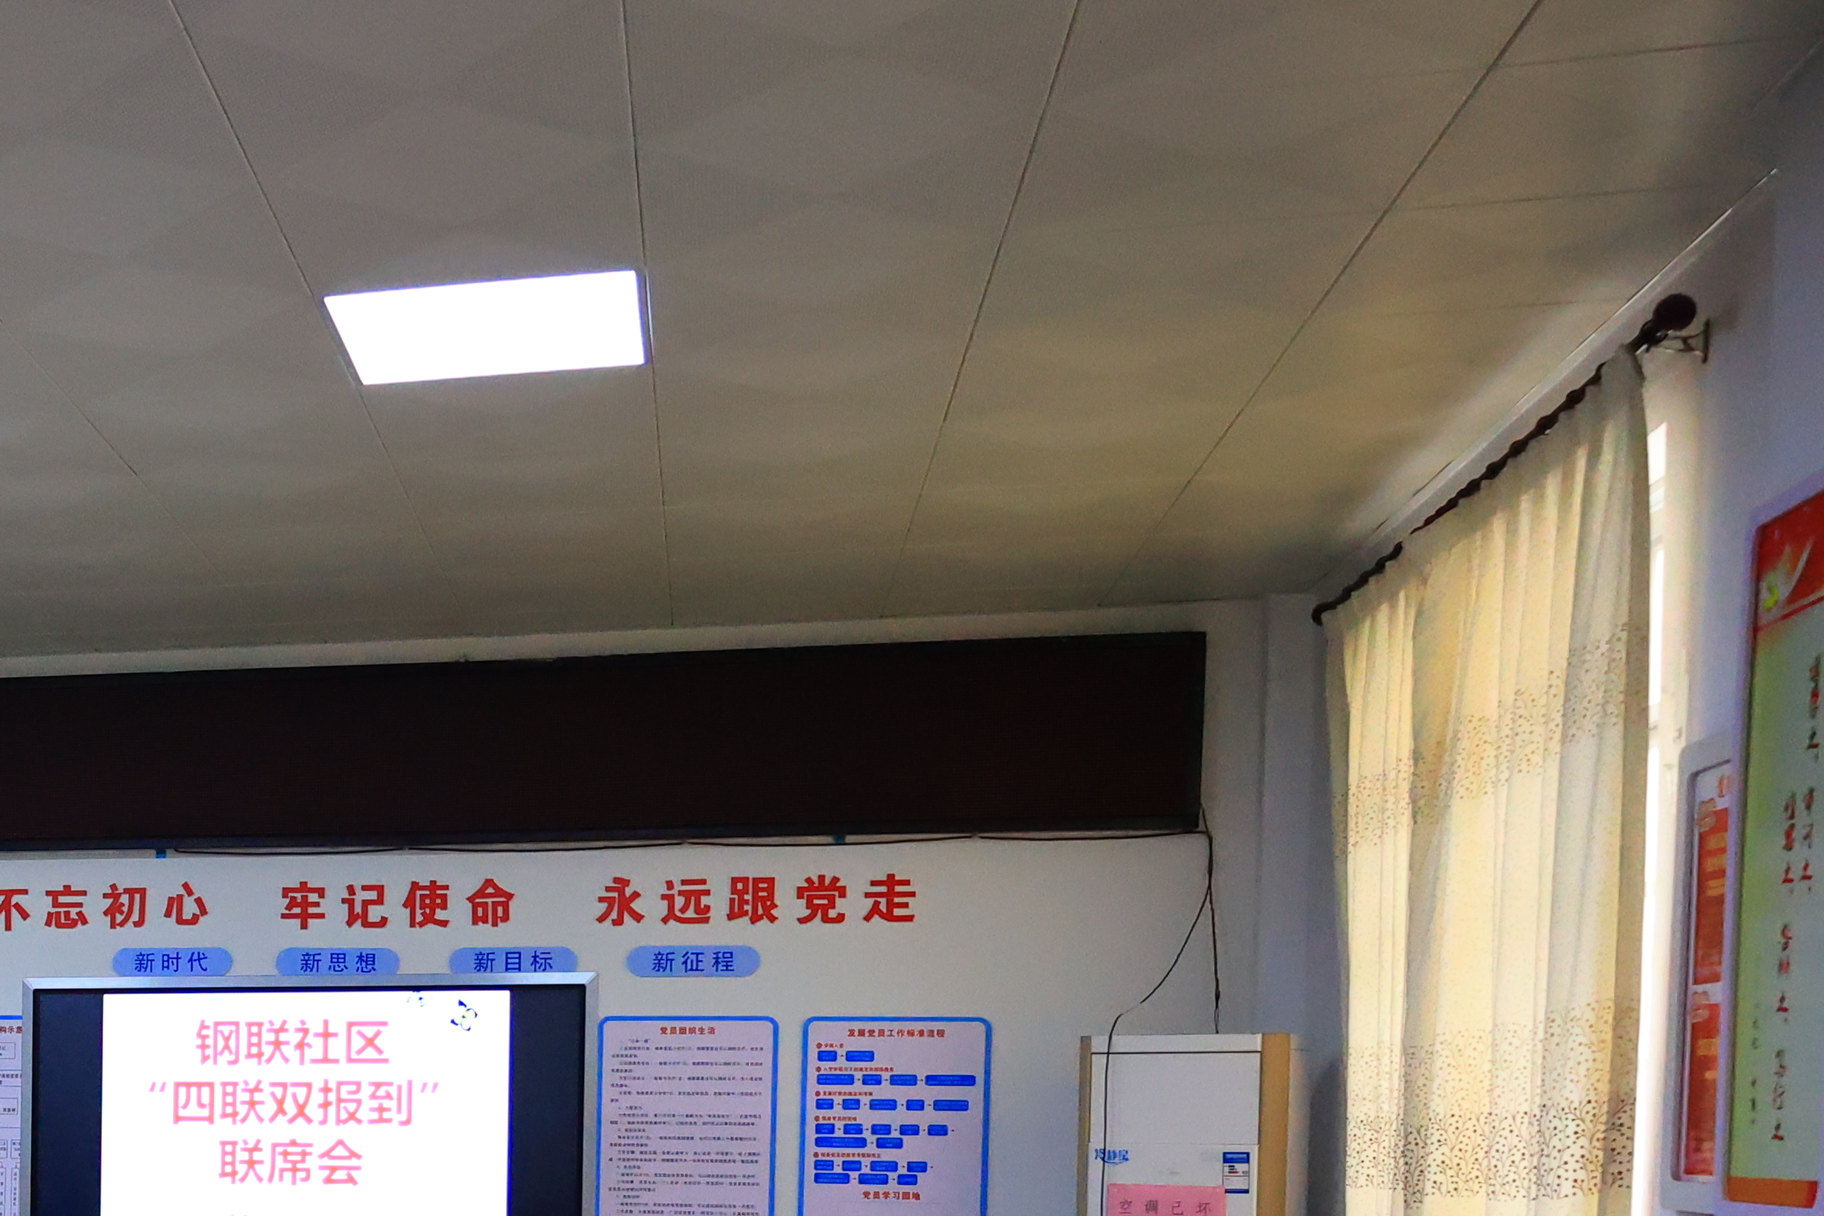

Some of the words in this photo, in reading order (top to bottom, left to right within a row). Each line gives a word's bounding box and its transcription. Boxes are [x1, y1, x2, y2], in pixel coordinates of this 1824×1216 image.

[280, 878, 516, 930] 牢记使命
[596, 873, 918, 927] 永远跟党走
[134, 951, 209, 974] 新时代
[299, 951, 377, 974] 新思想
[473, 950, 554, 973] 新目标
[651, 950, 735, 974] 新征程
[195, 1018, 390, 1066] 钢联社区
[149, 1078, 440, 1127] “四联双报到”
[218, 1138, 363, 1187] 联席会
